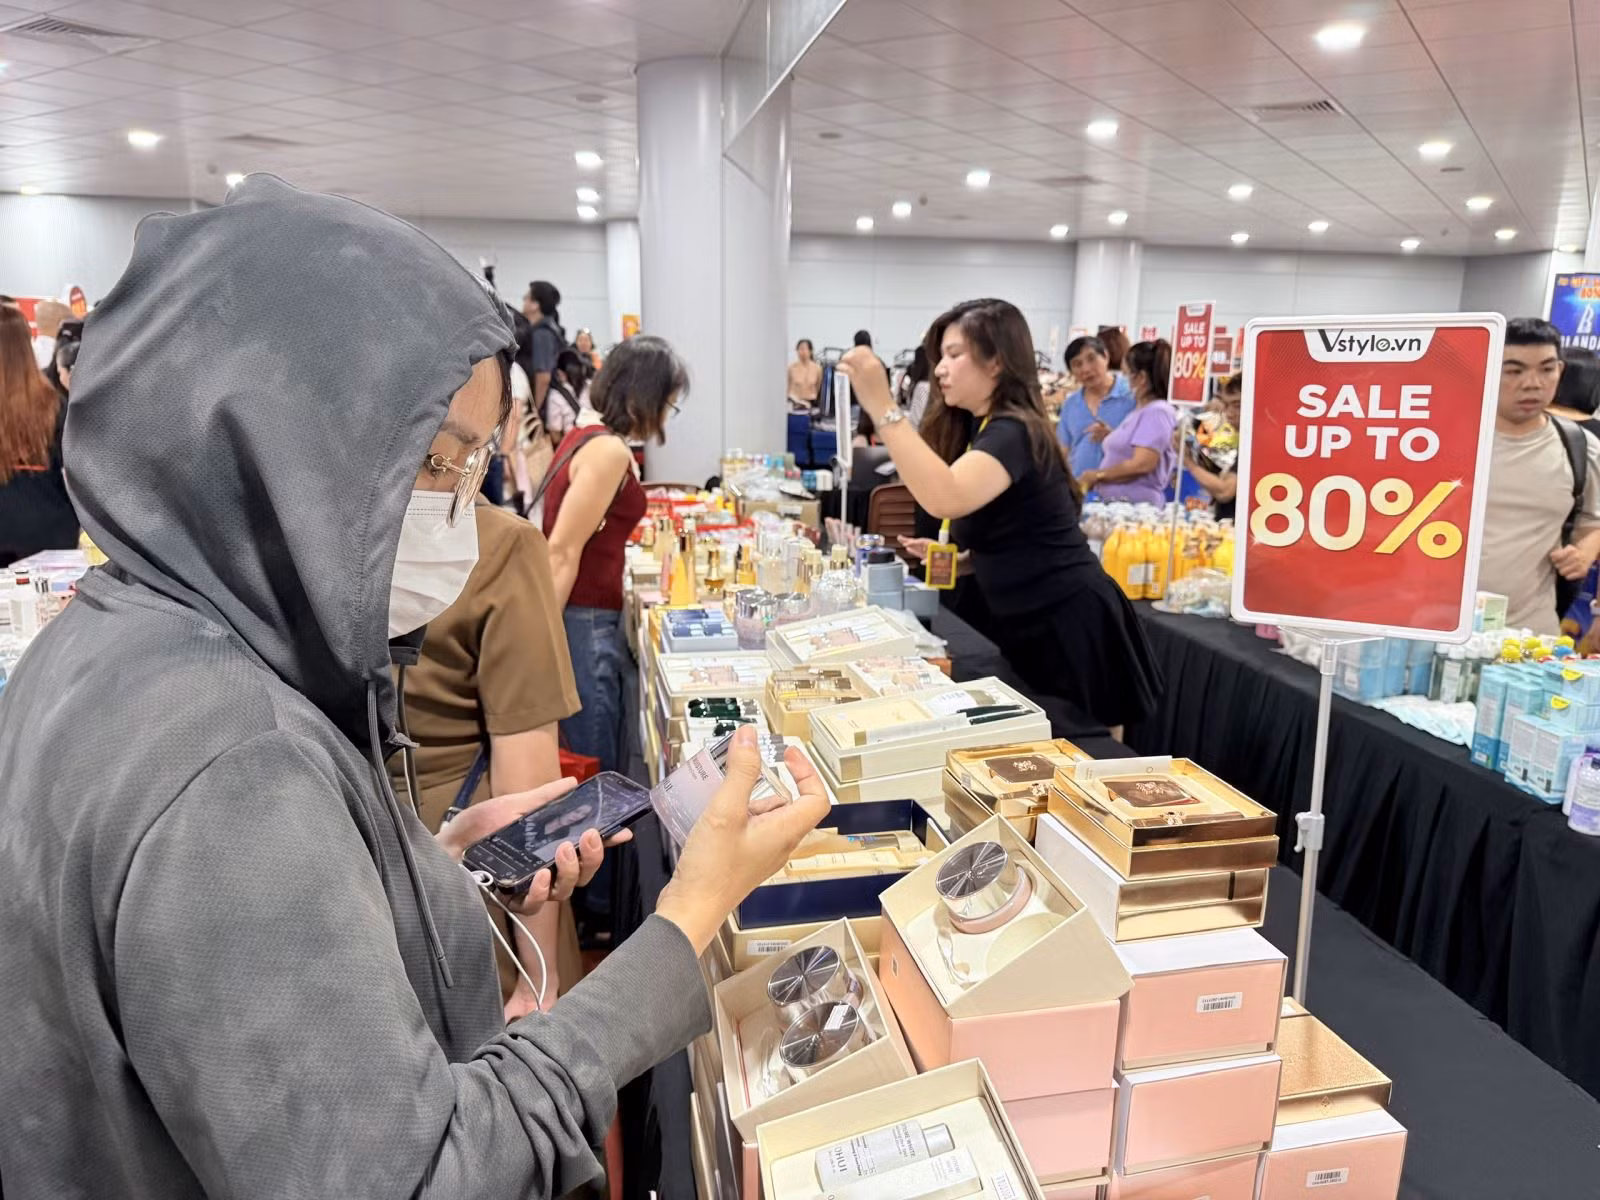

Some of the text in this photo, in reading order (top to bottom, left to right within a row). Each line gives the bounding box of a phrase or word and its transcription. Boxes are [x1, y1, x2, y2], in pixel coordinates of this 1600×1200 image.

[1184, 321, 1205, 334] SALE
[1180, 336, 1193, 348] UP
[1193, 336, 1206, 348] TO
[1173, 352, 1207, 378] 80%
[1296, 384, 1432, 419] SALE
[1284, 425, 1440, 462] UP TO
[1249, 472, 1463, 559] 80%
[834, 1147, 848, 1172] OHUI
